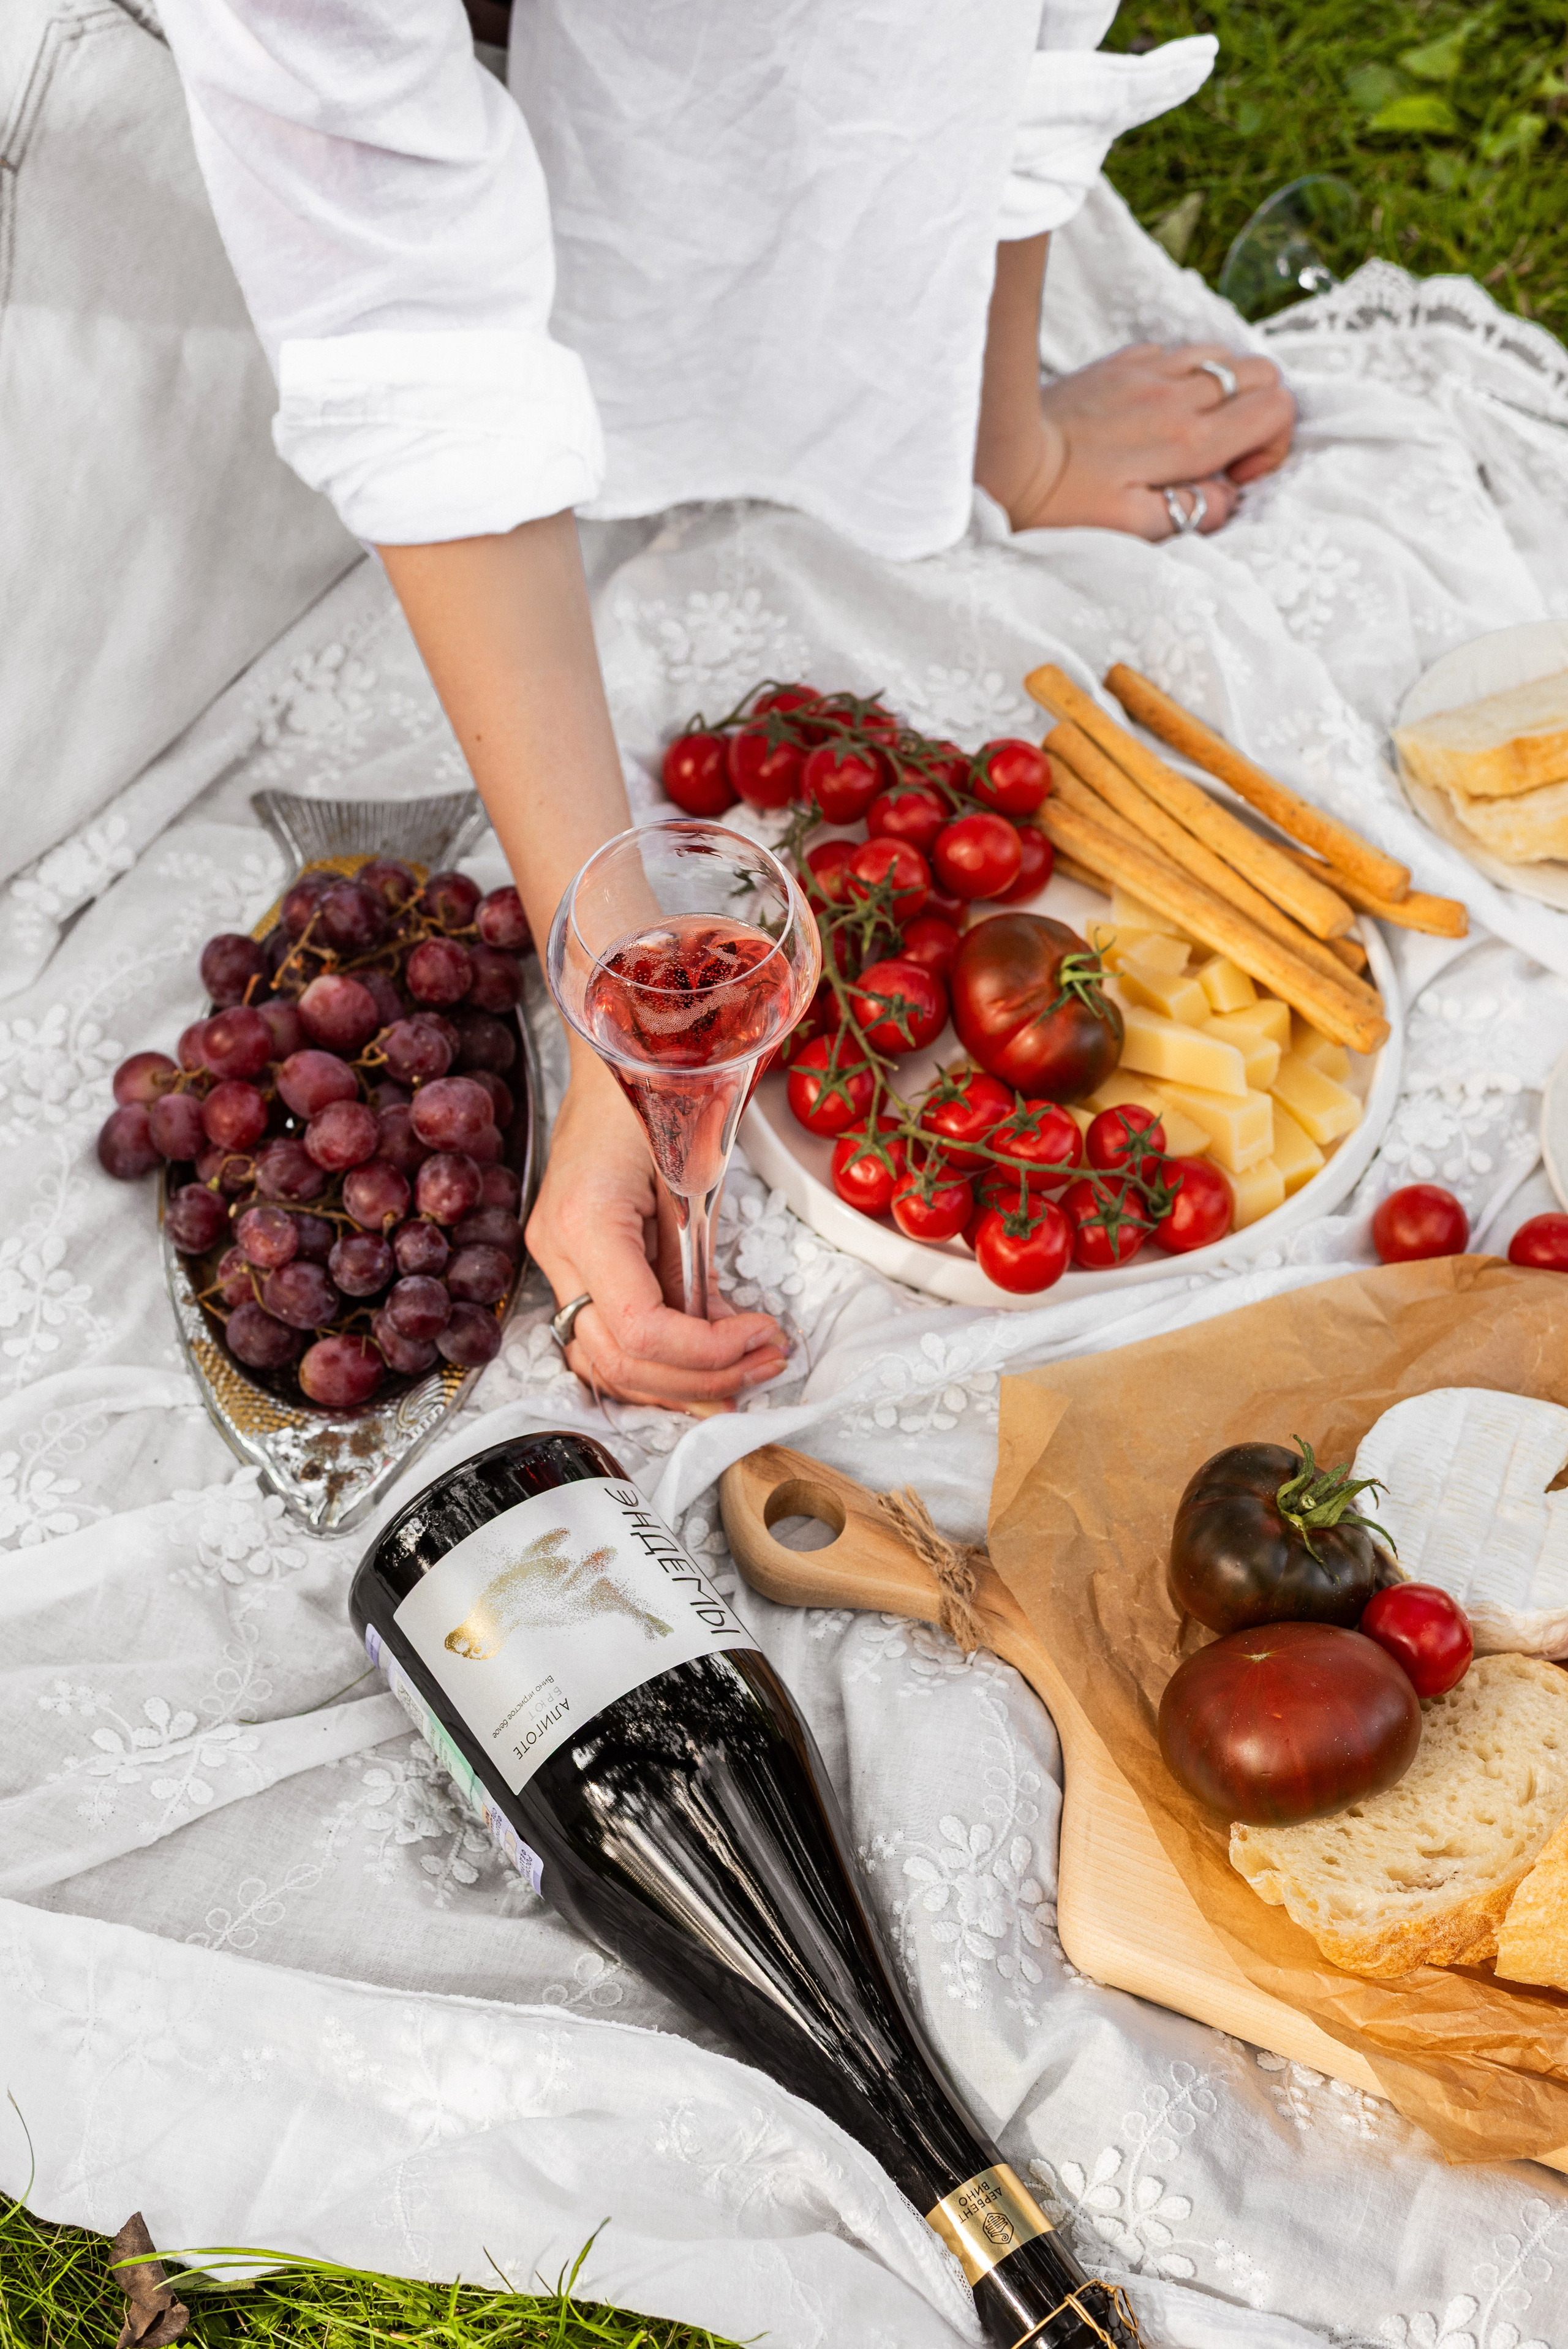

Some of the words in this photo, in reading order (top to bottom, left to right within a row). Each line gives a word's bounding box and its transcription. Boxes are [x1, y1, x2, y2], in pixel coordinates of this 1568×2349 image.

[604, 1488, 741, 1634] ЭНДЕМЫ
[535, 1675, 554, 1692] Вино
[508, 1691, 535, 1720] игристое
[528, 1686, 562, 1721] БРЮТ
[492, 1719, 508, 1738] белое
[513, 1697, 570, 1760] АЛИГОТЕ
[958, 2187, 1003, 2224] ДЕРБЕНТ
[959, 2181, 990, 2206] ВИНО
